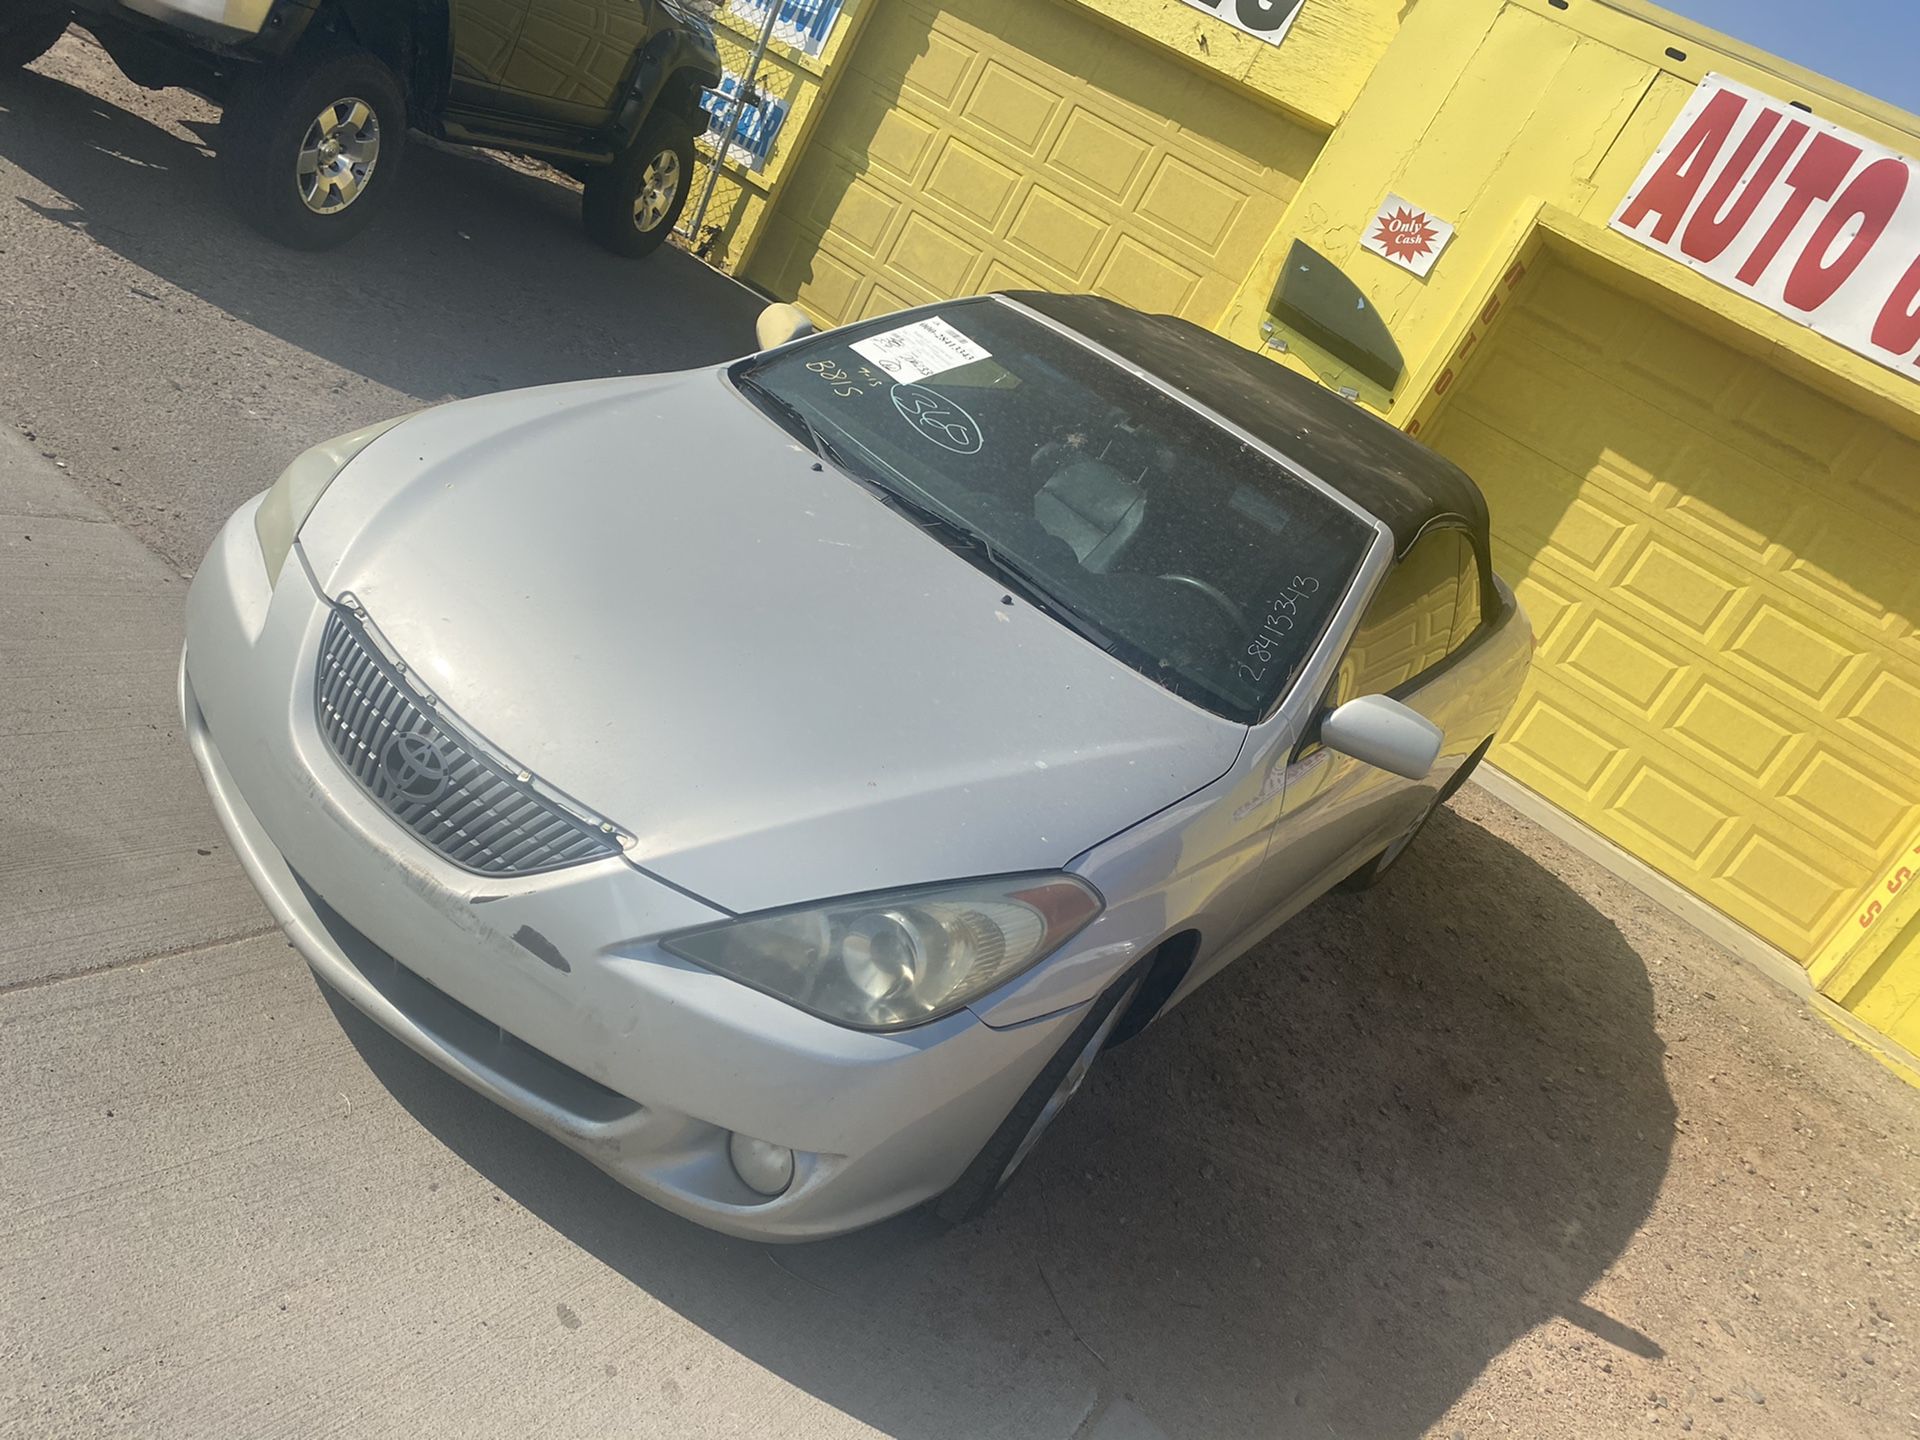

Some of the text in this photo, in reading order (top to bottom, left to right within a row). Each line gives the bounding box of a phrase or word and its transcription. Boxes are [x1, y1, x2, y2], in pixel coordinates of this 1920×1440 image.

[1618, 88, 1910, 312] AUTO
[1388, 219, 1423, 235] Only
[1395, 234, 1423, 245] Cash
[805, 360, 864, 399] B815
